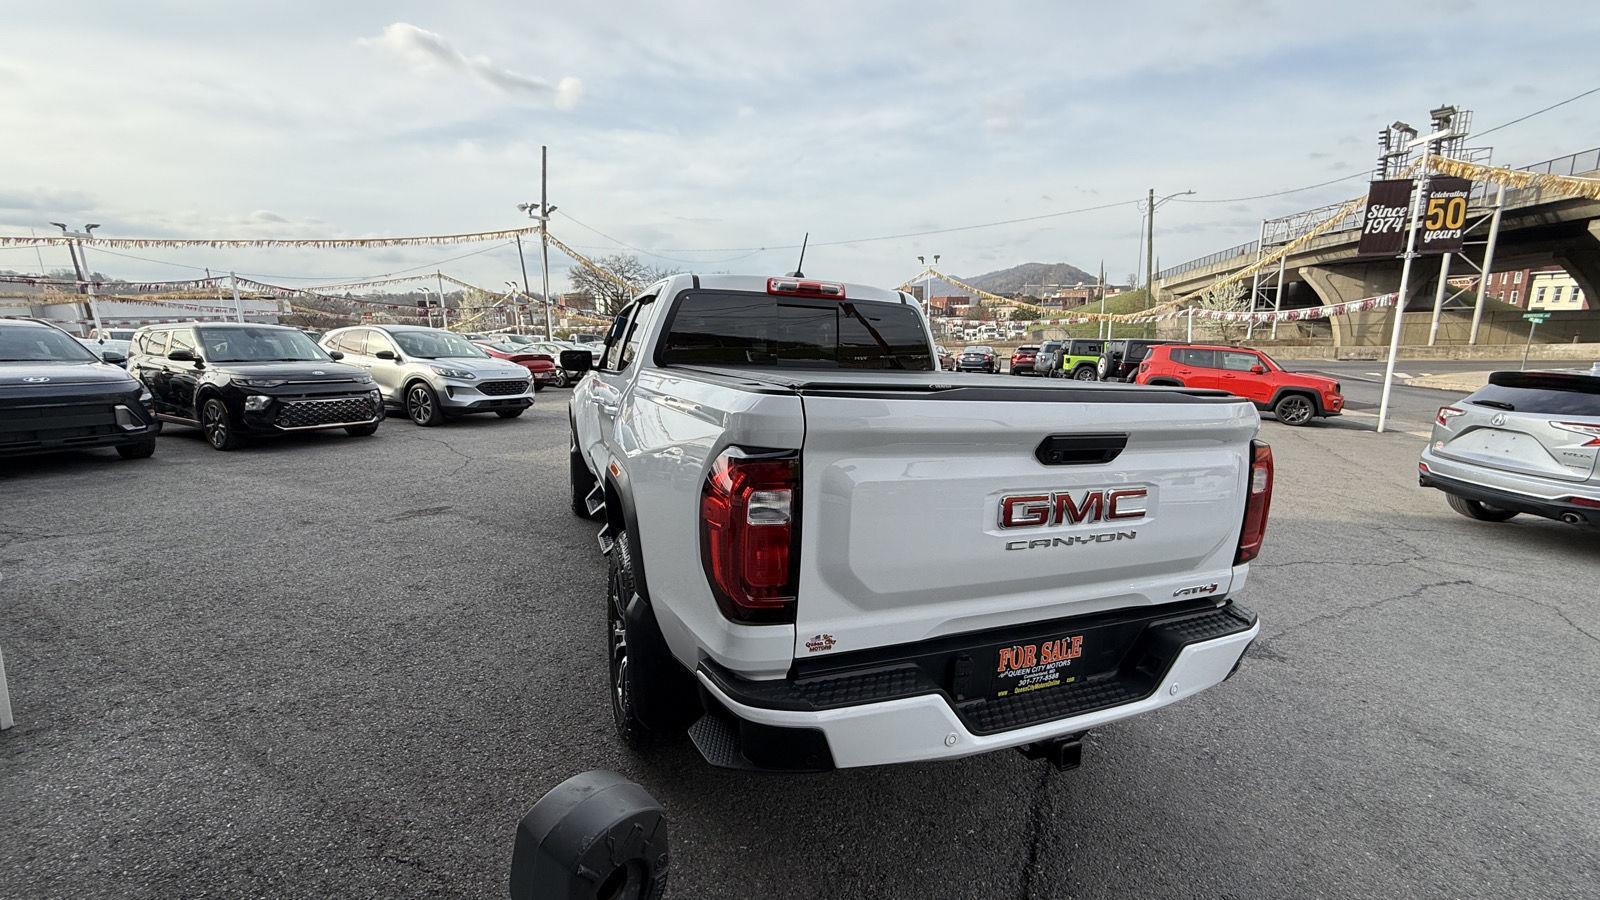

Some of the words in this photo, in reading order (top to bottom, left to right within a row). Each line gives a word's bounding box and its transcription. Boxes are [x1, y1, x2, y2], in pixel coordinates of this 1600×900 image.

[1367, 205, 1407, 218] Since
[1425, 198, 1466, 230] 50
[1364, 219, 1402, 234] 1974
[1424, 230, 1460, 243] years
[997, 487, 1148, 530] GMC
[1005, 530, 1136, 550] CANYON
[997, 645, 1037, 672] FOR
[1040, 636, 1083, 664] SALE
[1008, 668, 1031, 676] QUEEN
[1031, 665, 1045, 673] CITY
[1046, 660, 1071, 669] MOTORS
